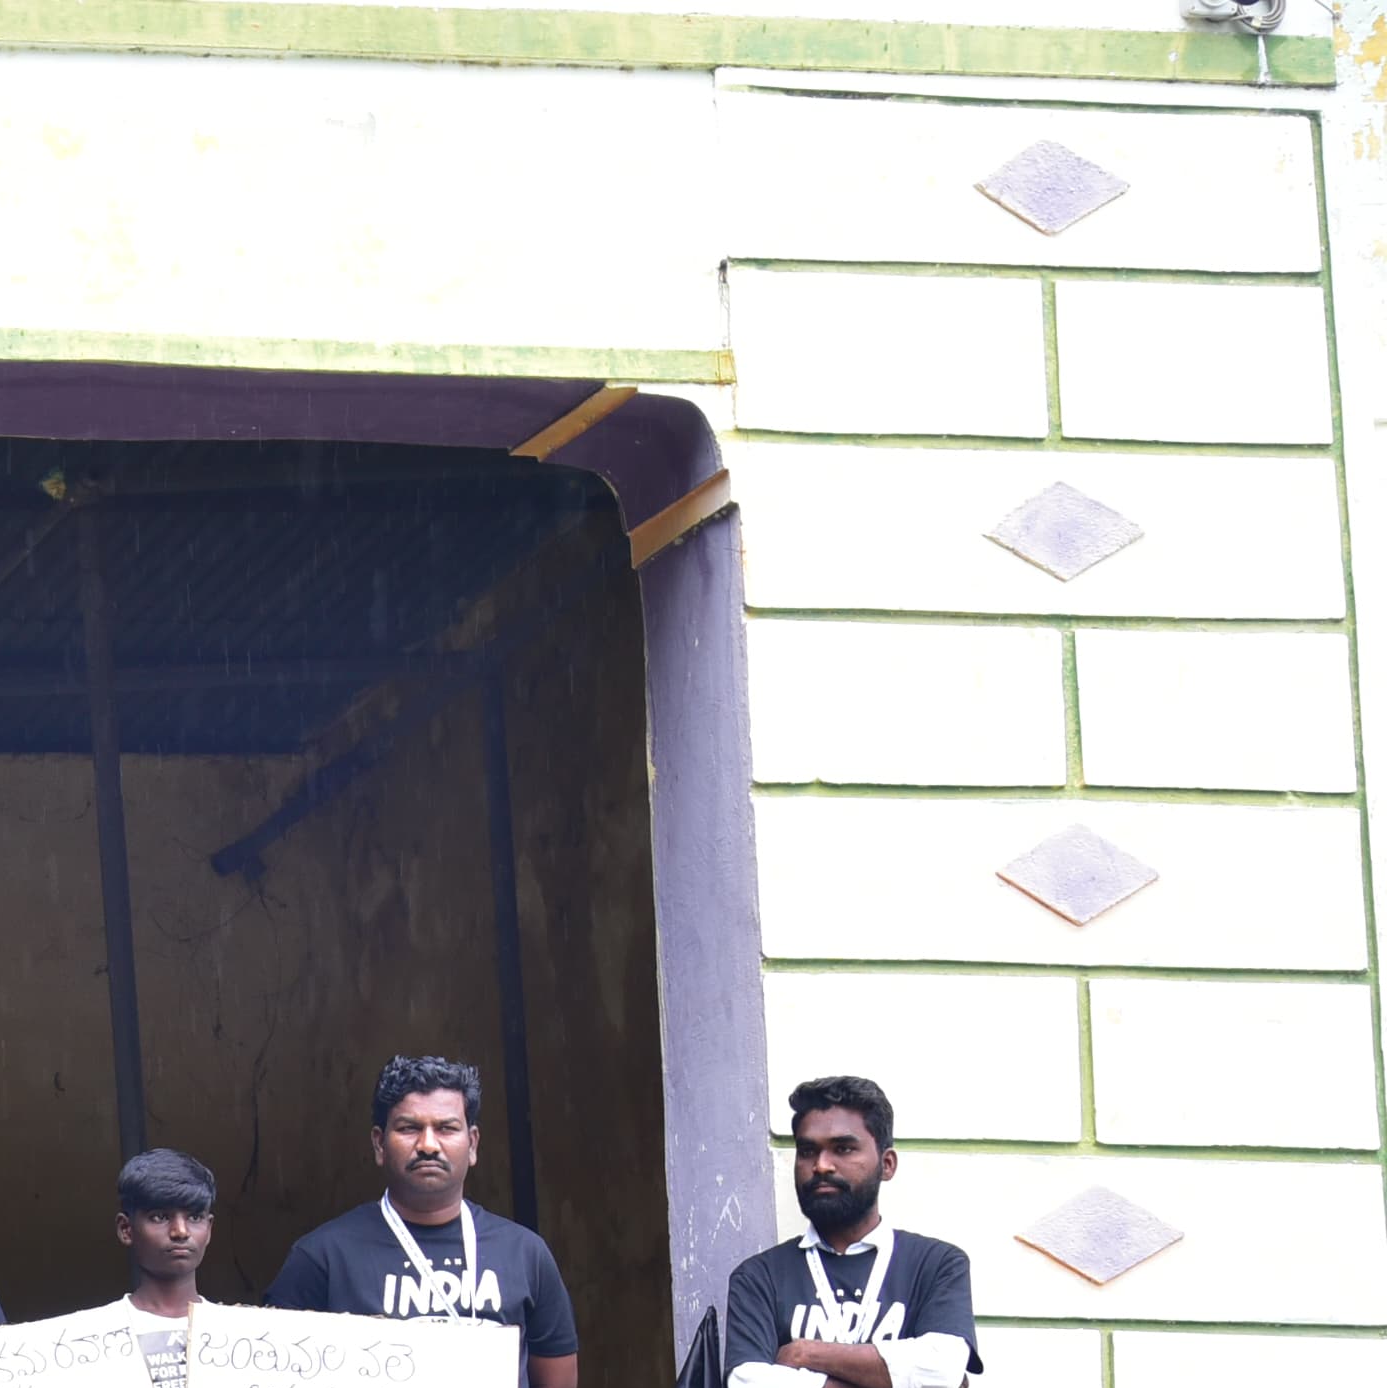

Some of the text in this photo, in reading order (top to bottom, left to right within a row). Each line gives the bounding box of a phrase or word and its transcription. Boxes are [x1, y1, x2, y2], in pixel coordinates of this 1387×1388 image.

[383, 1269, 502, 1317] INDIA
[790, 1301, 906, 1343] INDIA
[147, 1352, 186, 1366] WALK
[151, 1365, 179, 1379] FOR
[198, 1332, 415, 1382] జంతువుల వలె
